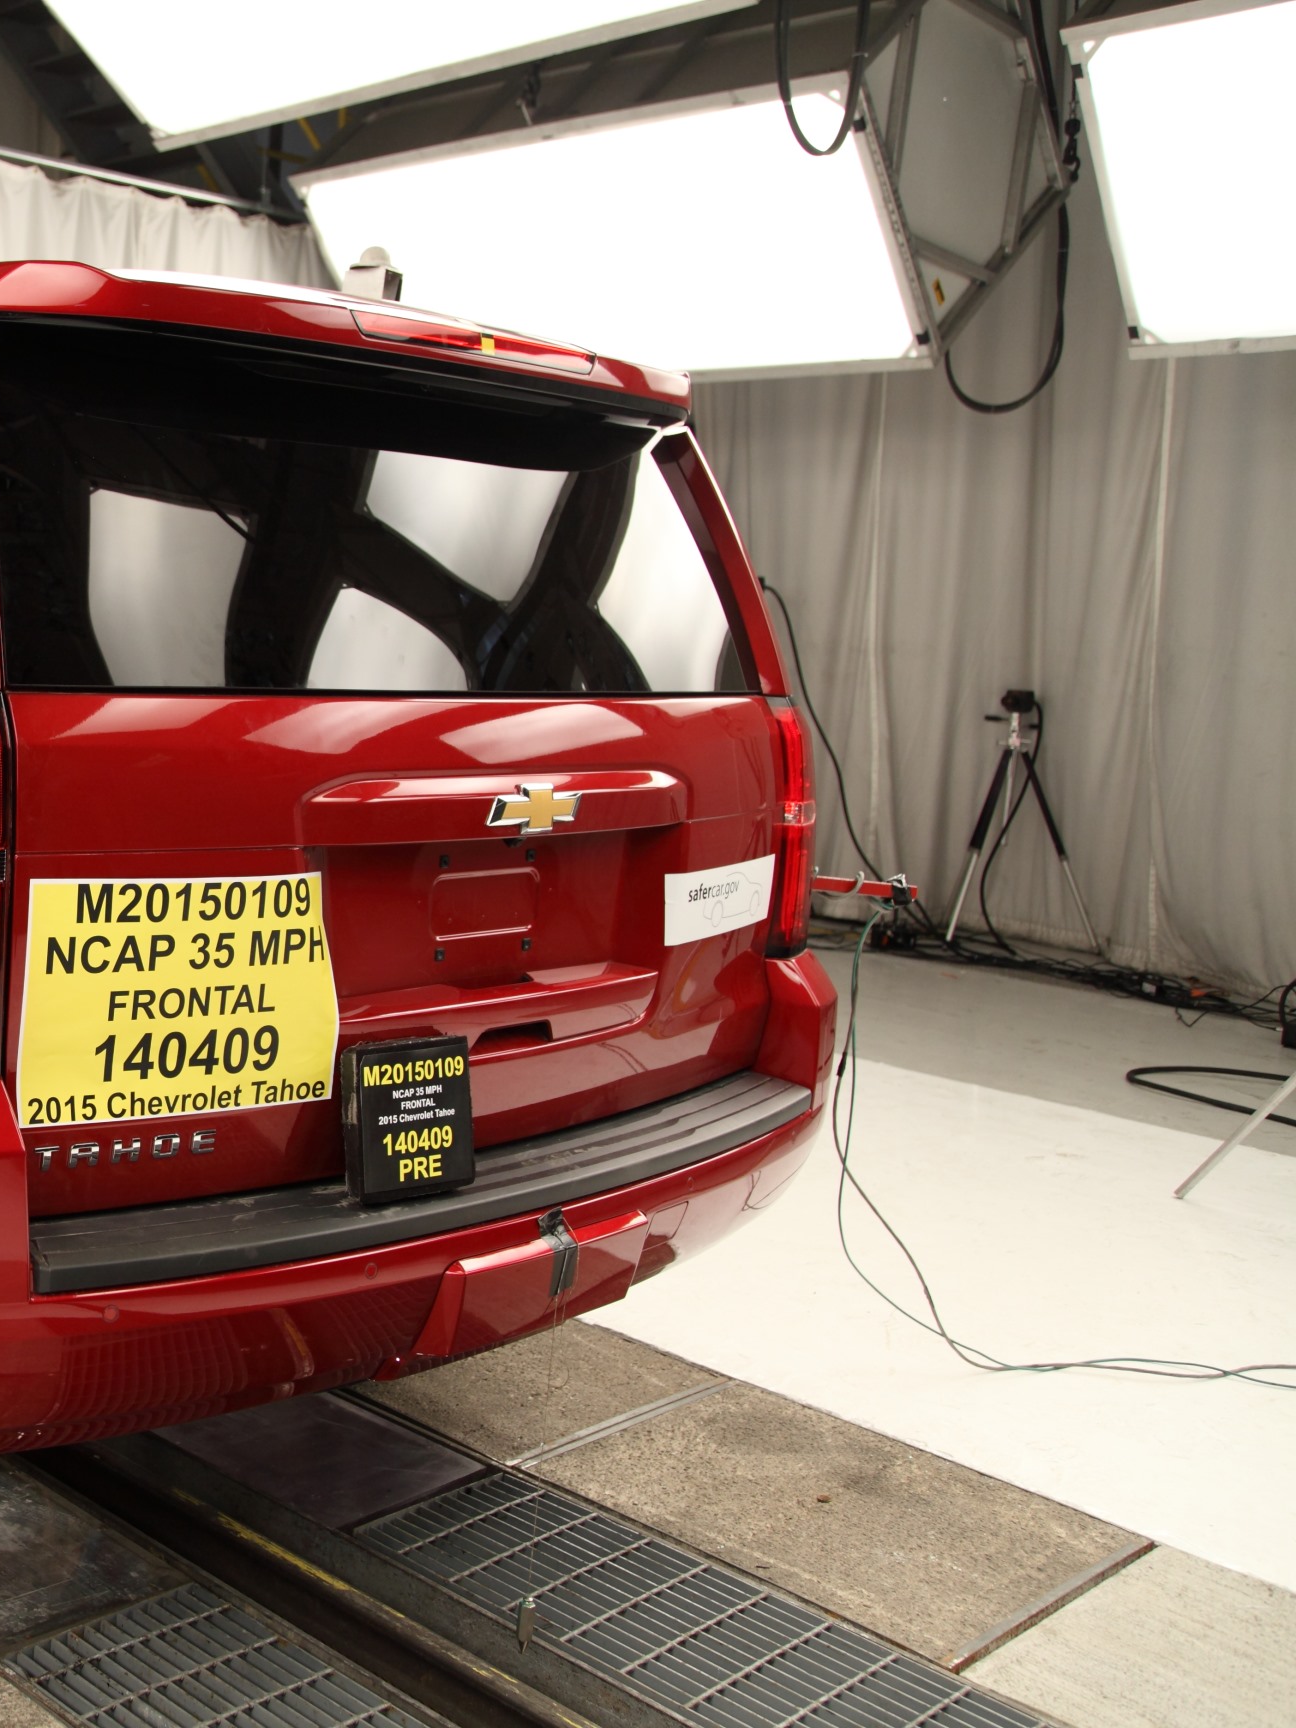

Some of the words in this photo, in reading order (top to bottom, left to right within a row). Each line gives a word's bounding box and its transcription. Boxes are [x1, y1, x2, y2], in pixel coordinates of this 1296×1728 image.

[76, 877, 311, 924] M20150109
[688, 880, 740, 902] safercar.gov
[45, 934, 176, 975] NCAP
[189, 932, 235, 970] 35
[249, 925, 325, 967] MPH
[107, 983, 276, 1022] FRONTAL
[95, 1025, 280, 1083] 140409
[363, 1056, 464, 1087] M20150109
[27, 1094, 97, 1125] 2015
[107, 1084, 242, 1119] Chevrolet
[251, 1078, 325, 1105] Tahoe
[392, 1088, 415, 1100] NCAP
[415, 1086, 424, 1097] 35
[425, 1084, 443, 1095] MPH
[401, 1097, 436, 1111] FRONTAL
[378, 1113, 398, 1126] 2015
[399, 1109, 434, 1123] Chevrolet
[435, 1107, 456, 1118] Tahoe
[34, 1128, 217, 1172] TAHOE
[382, 1125, 453, 1156] 140409
[399, 1154, 443, 1182] PRE
